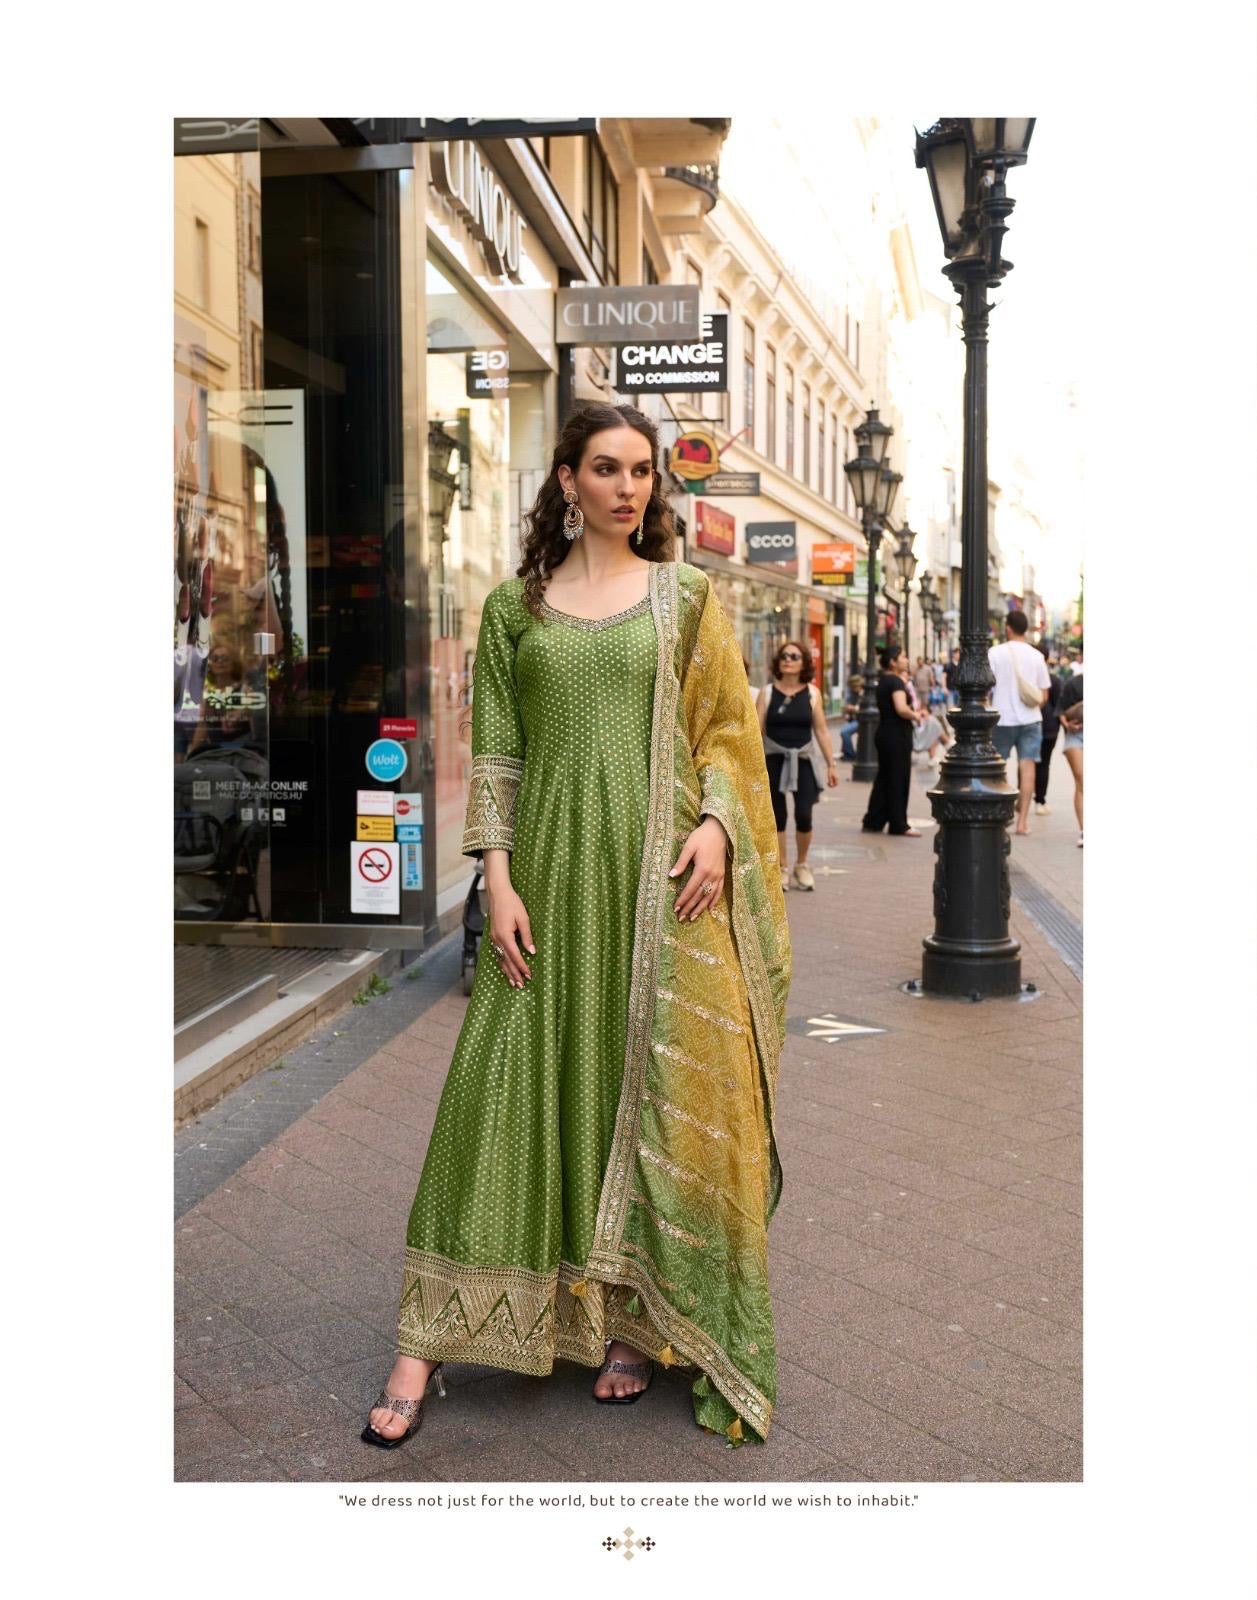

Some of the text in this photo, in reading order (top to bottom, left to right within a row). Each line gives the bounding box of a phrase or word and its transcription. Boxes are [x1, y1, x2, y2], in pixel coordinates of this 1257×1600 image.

[563, 300, 693, 328] CLINIQUE
[621, 342, 724, 366] CHANGE
[625, 371, 720, 384] NO COMMISSION
[750, 534, 794, 549] ecco
[373, 753, 399, 766] Wolt
[215, 781, 240, 791] MEET
[271, 781, 308, 791] ONLINE
